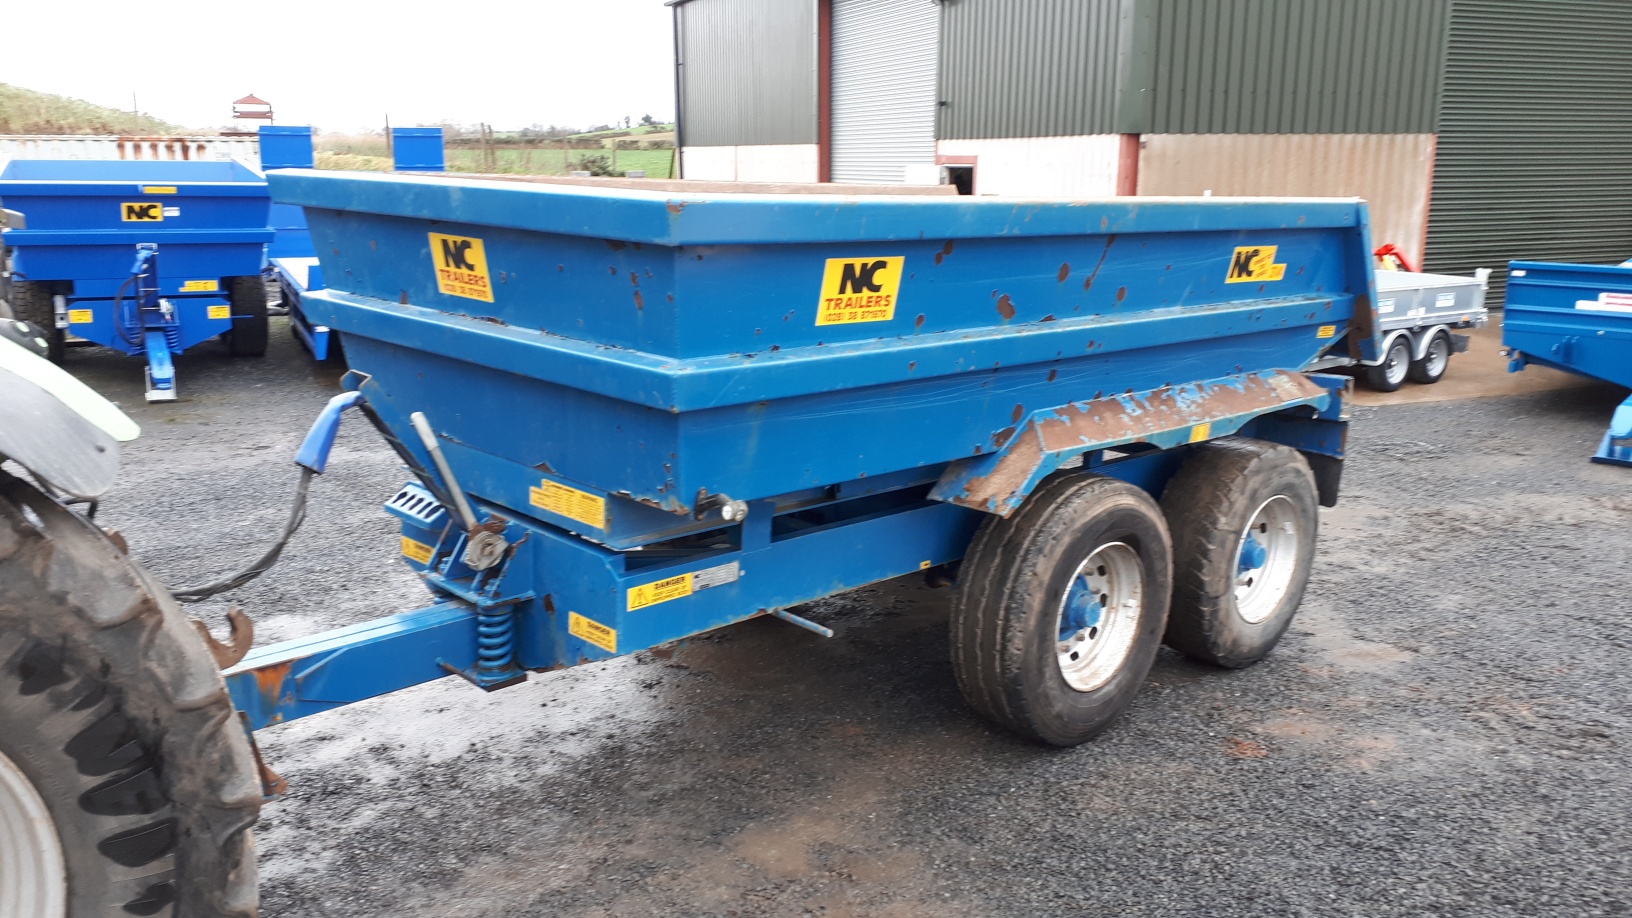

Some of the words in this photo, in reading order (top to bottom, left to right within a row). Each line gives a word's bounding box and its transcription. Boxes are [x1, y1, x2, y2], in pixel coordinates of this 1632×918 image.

[126, 204, 158, 220] NC
[440, 238, 475, 272] NC
[1229, 248, 1260, 279] NC
[439, 268, 488, 288] TRAILERS
[838, 260, 888, 295] NC
[825, 294, 891, 311] TRAILERS
[654, 576, 686, 590] DANGER
